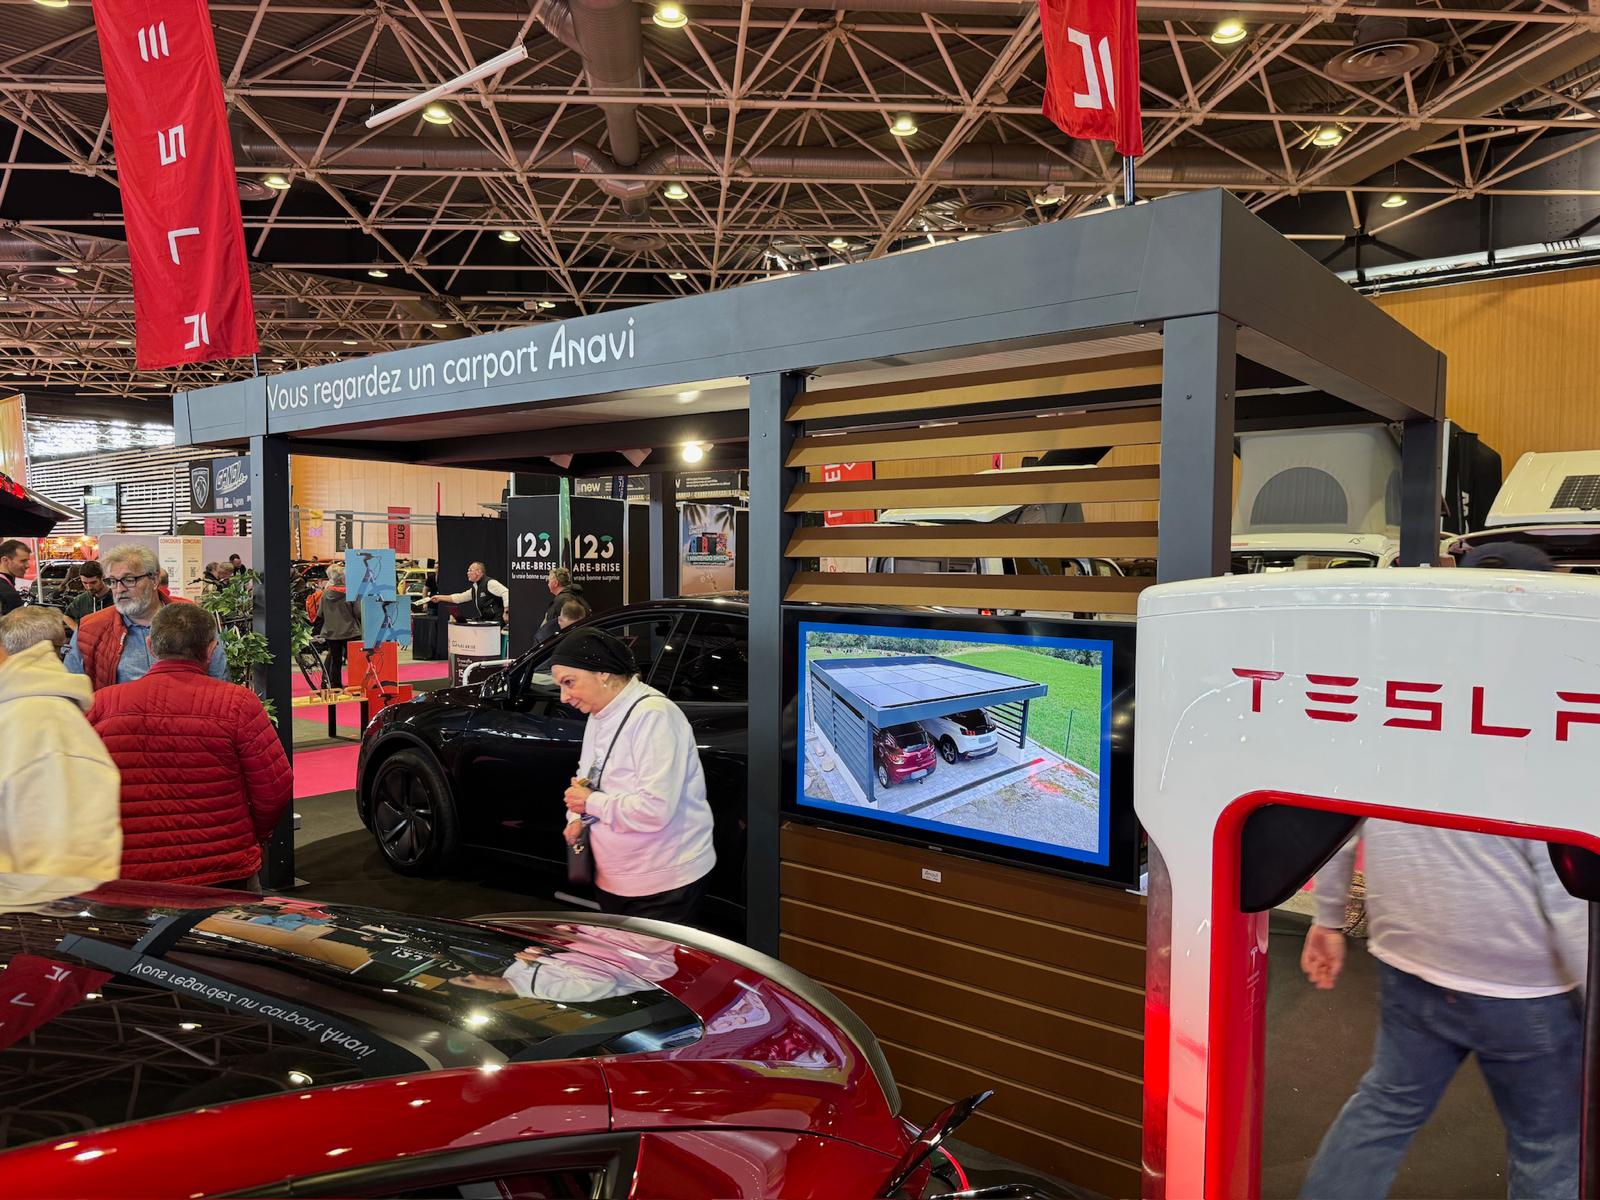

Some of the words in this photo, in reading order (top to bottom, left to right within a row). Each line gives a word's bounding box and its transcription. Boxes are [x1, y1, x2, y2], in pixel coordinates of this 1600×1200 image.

[137, 20, 210, 350] ESLA
[267, 383, 308, 411] Vous
[313, 364, 401, 409] regardez
[408, 364, 435, 391] un
[442, 340, 538, 387] carport
[547, 316, 635, 371] Anavi
[580, 482, 600, 493] new
[516, 532, 551, 558] 123
[574, 534, 614, 559] 123
[511, 561, 557, 570] PARE-BRISE
[572, 562, 621, 572] ARE-BRISE
[587, 573, 602, 581] bonne
[602, 574, 621, 583] surprise
[1231, 667, 1600, 742] TESLA
